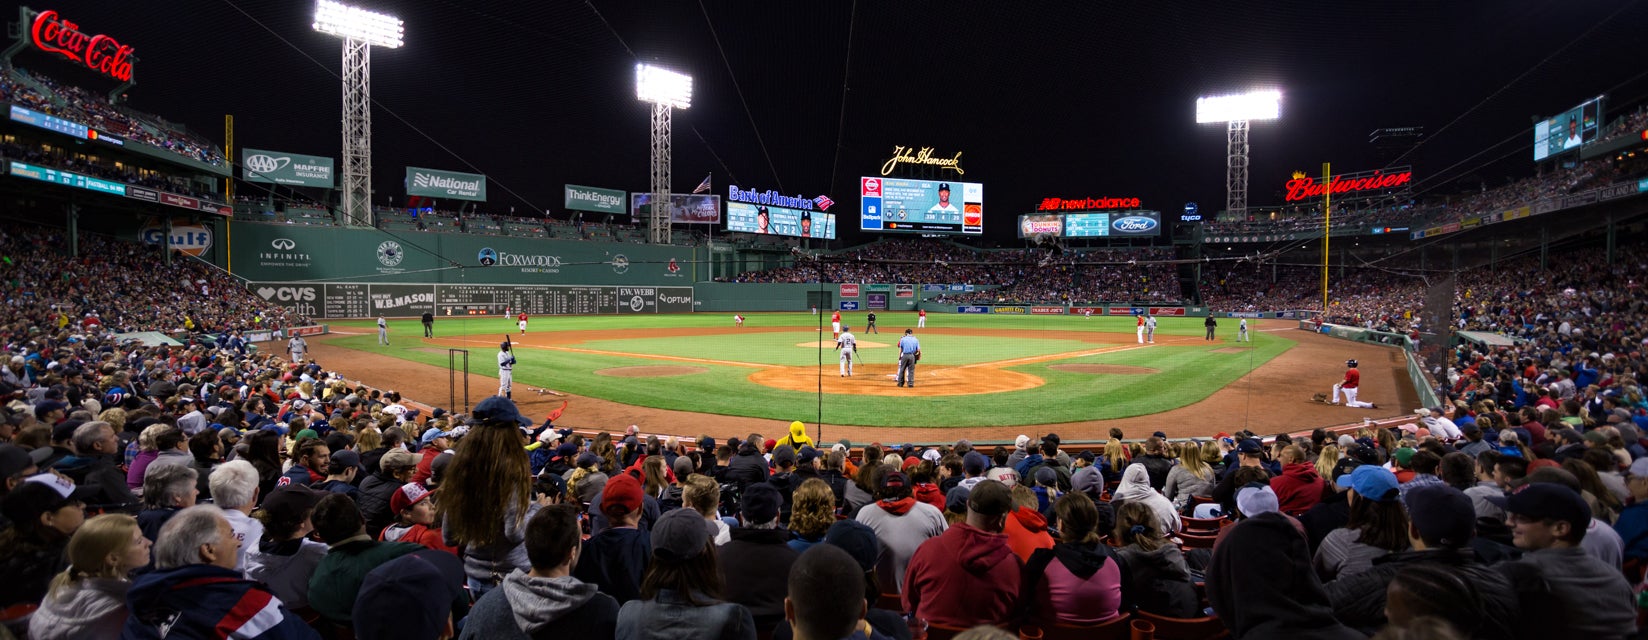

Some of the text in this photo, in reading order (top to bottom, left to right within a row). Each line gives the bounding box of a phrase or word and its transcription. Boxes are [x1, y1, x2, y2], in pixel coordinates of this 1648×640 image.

[881, 145, 964, 176] John Hancock
[294, 164, 330, 172] MAPFRE
[429, 176, 479, 191] National
[1285, 170, 1412, 202] Budweiser
[729, 185, 813, 210] Bank of America
[1061, 200, 1087, 209] new
[1087, 197, 1140, 208] balance
[1120, 220, 1149, 230] Ford
[144, 228, 208, 246] Gulf
[260, 252, 310, 260] INFINITI
[500, 252, 561, 266] FOXWOODS
[277, 287, 316, 301] CVS
